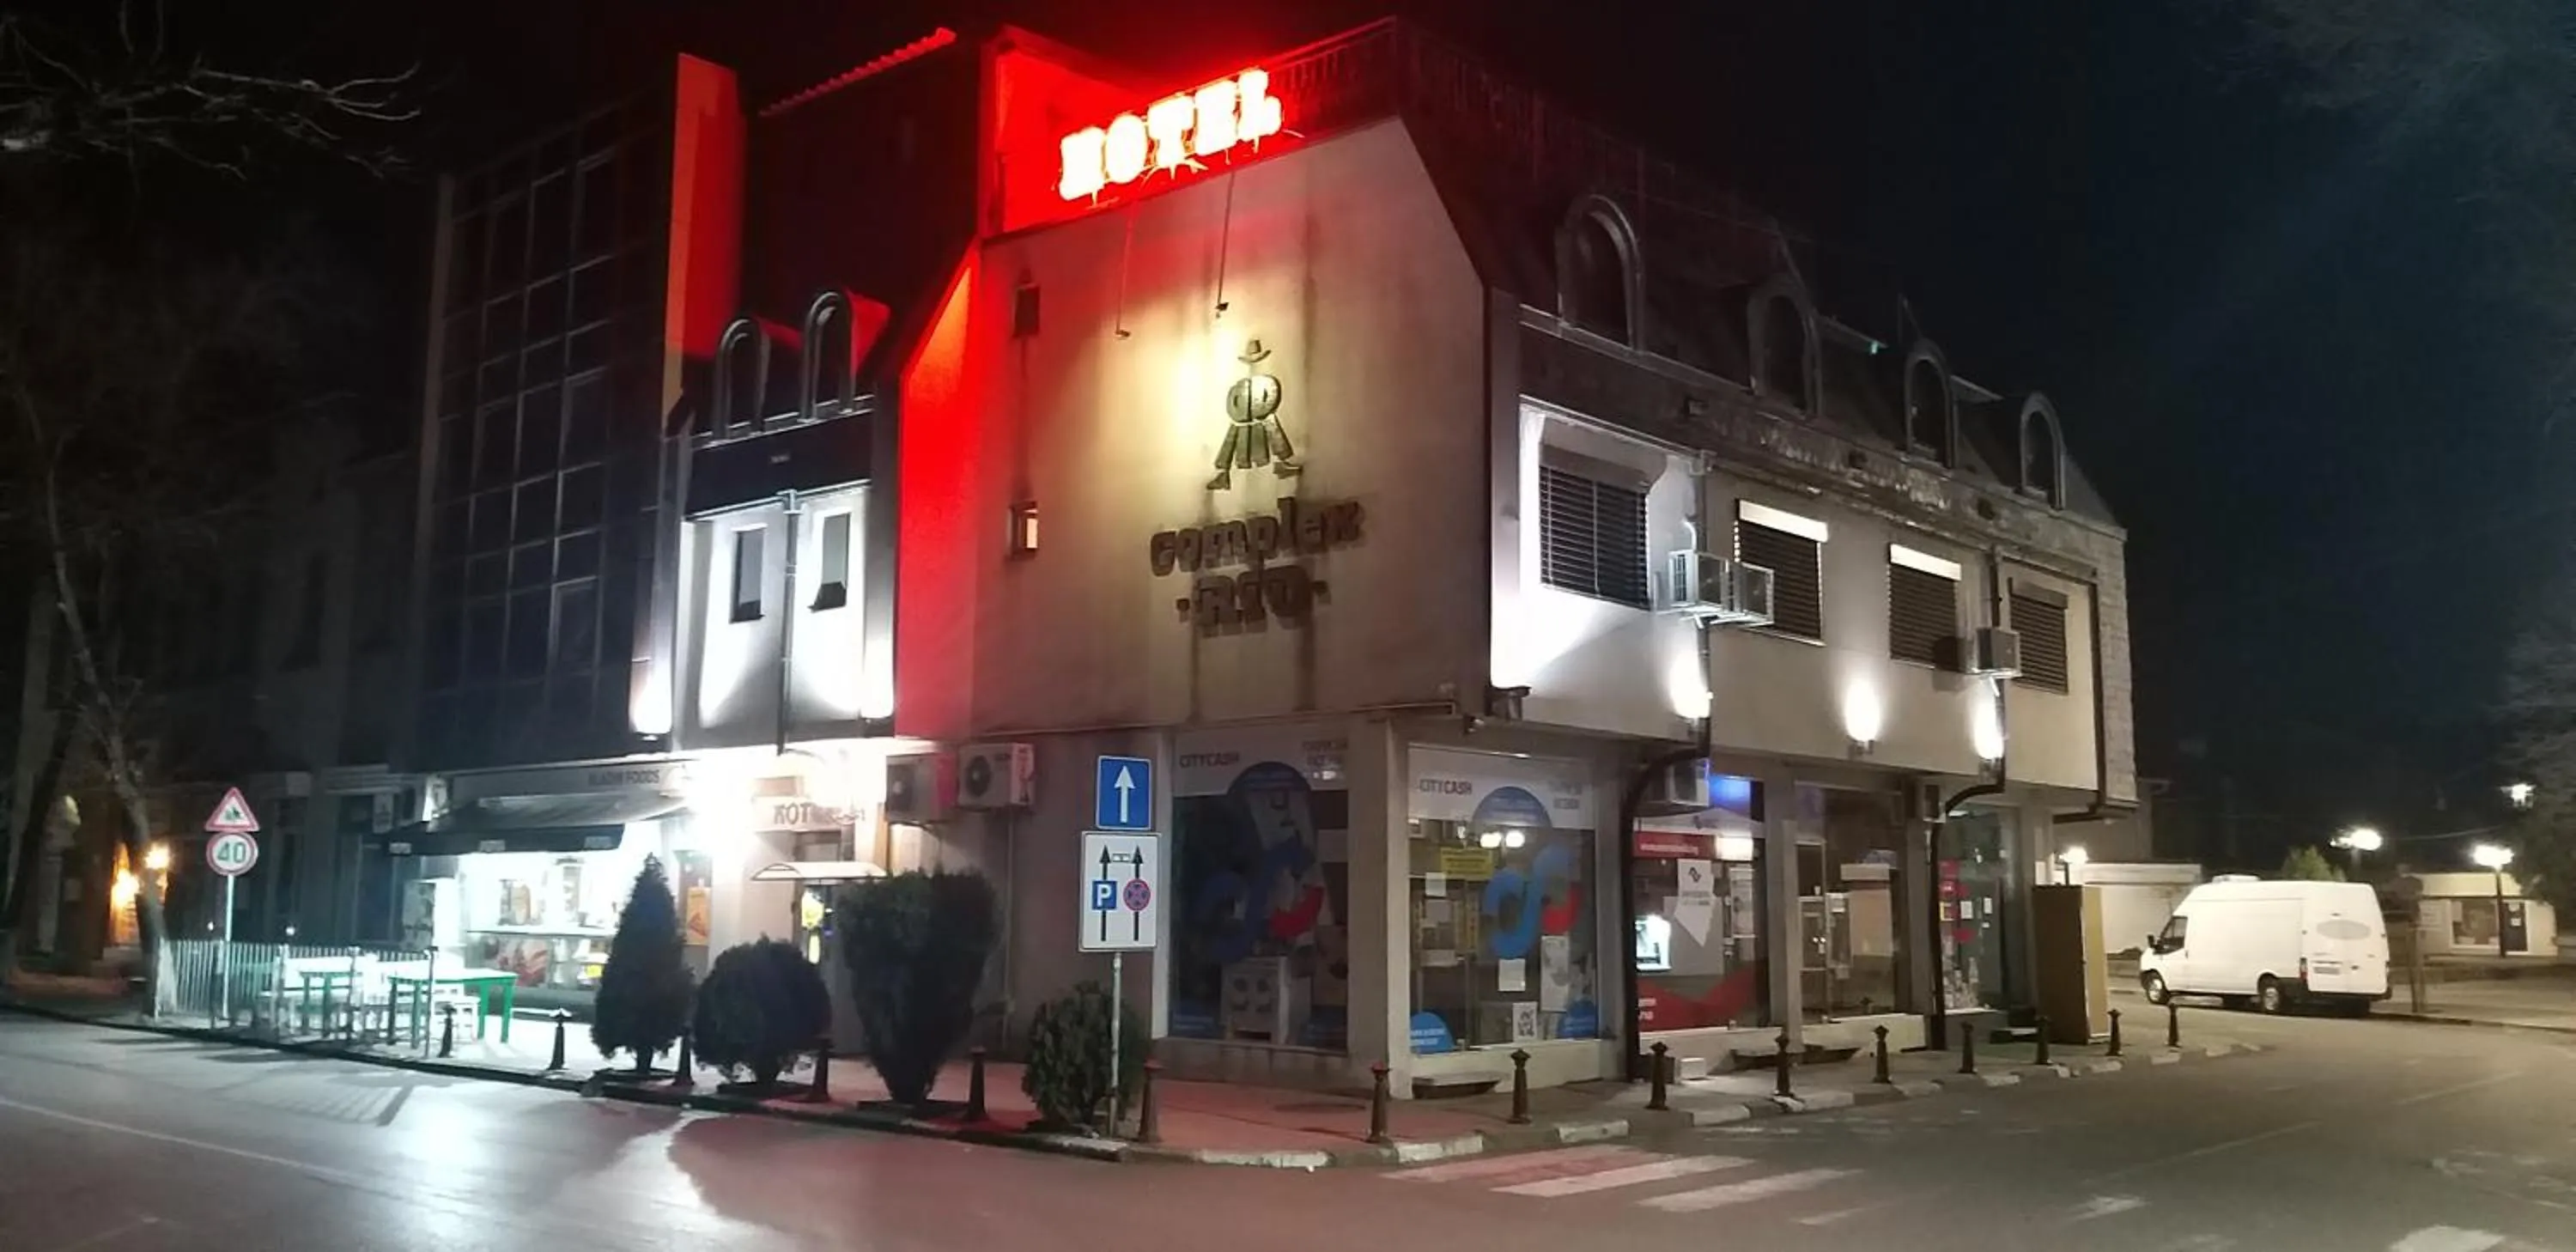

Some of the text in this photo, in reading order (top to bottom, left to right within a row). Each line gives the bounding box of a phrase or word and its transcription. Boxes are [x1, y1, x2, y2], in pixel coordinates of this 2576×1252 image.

[1060, 68, 1282, 200] HOTEL
[1179, 751, 1240, 768] CITYCASH
[1419, 779, 1473, 794] CITYCASH
[217, 842, 246, 863] 40
[1097, 884, 1112, 907] P
